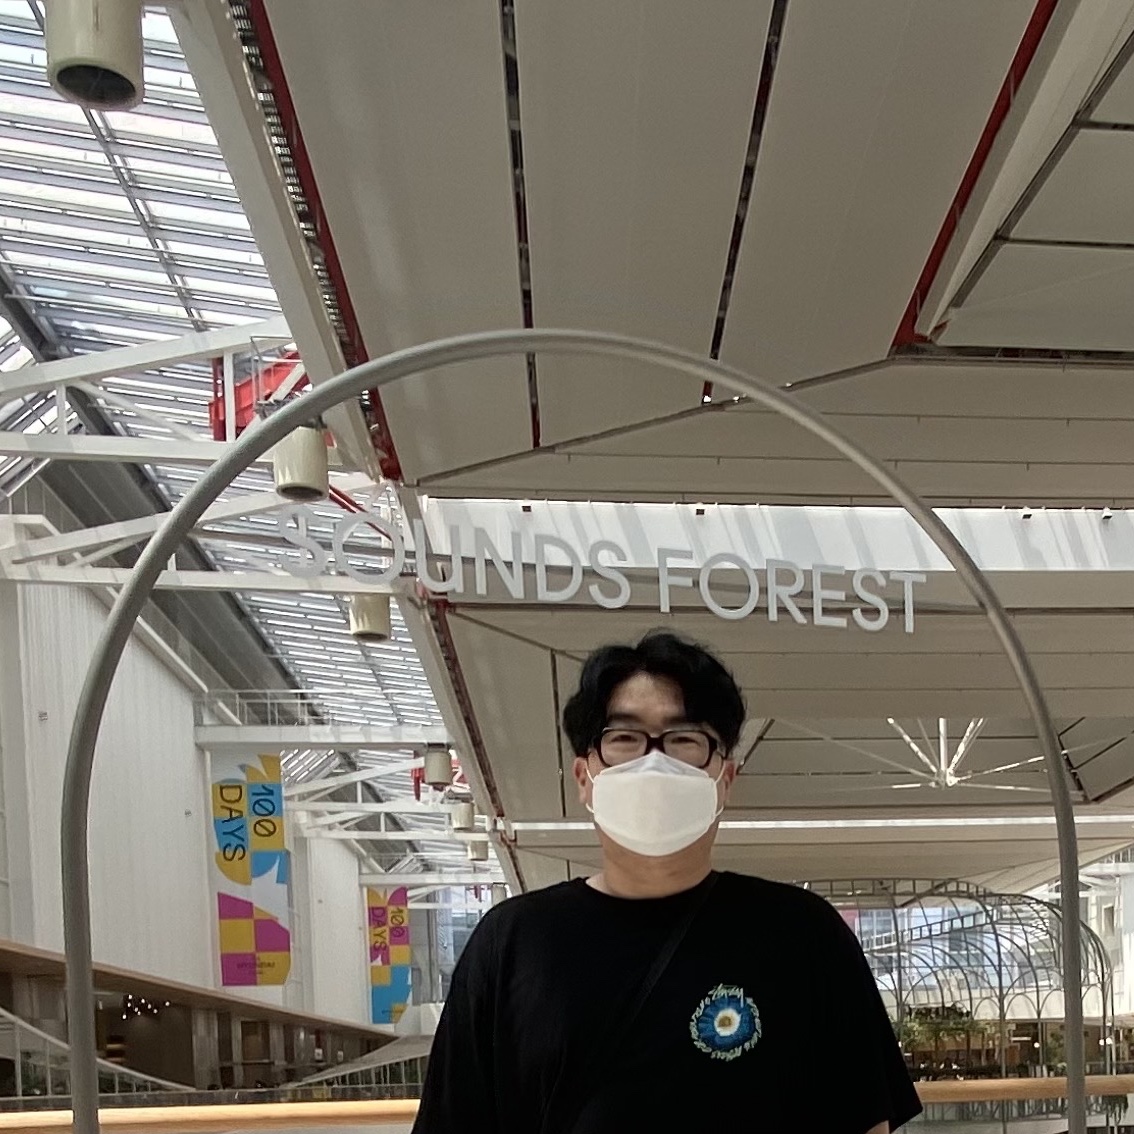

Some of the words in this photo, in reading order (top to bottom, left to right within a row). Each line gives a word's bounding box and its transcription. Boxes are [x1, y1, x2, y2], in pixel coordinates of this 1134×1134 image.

[277, 509, 632, 609] SOUNDS
[657, 547, 927, 634] FOREST
[218, 784, 246, 862] DAYS
[251, 784, 277, 838] 100
[372, 907, 387, 951] DAYS
[390, 907, 405, 938] 100
